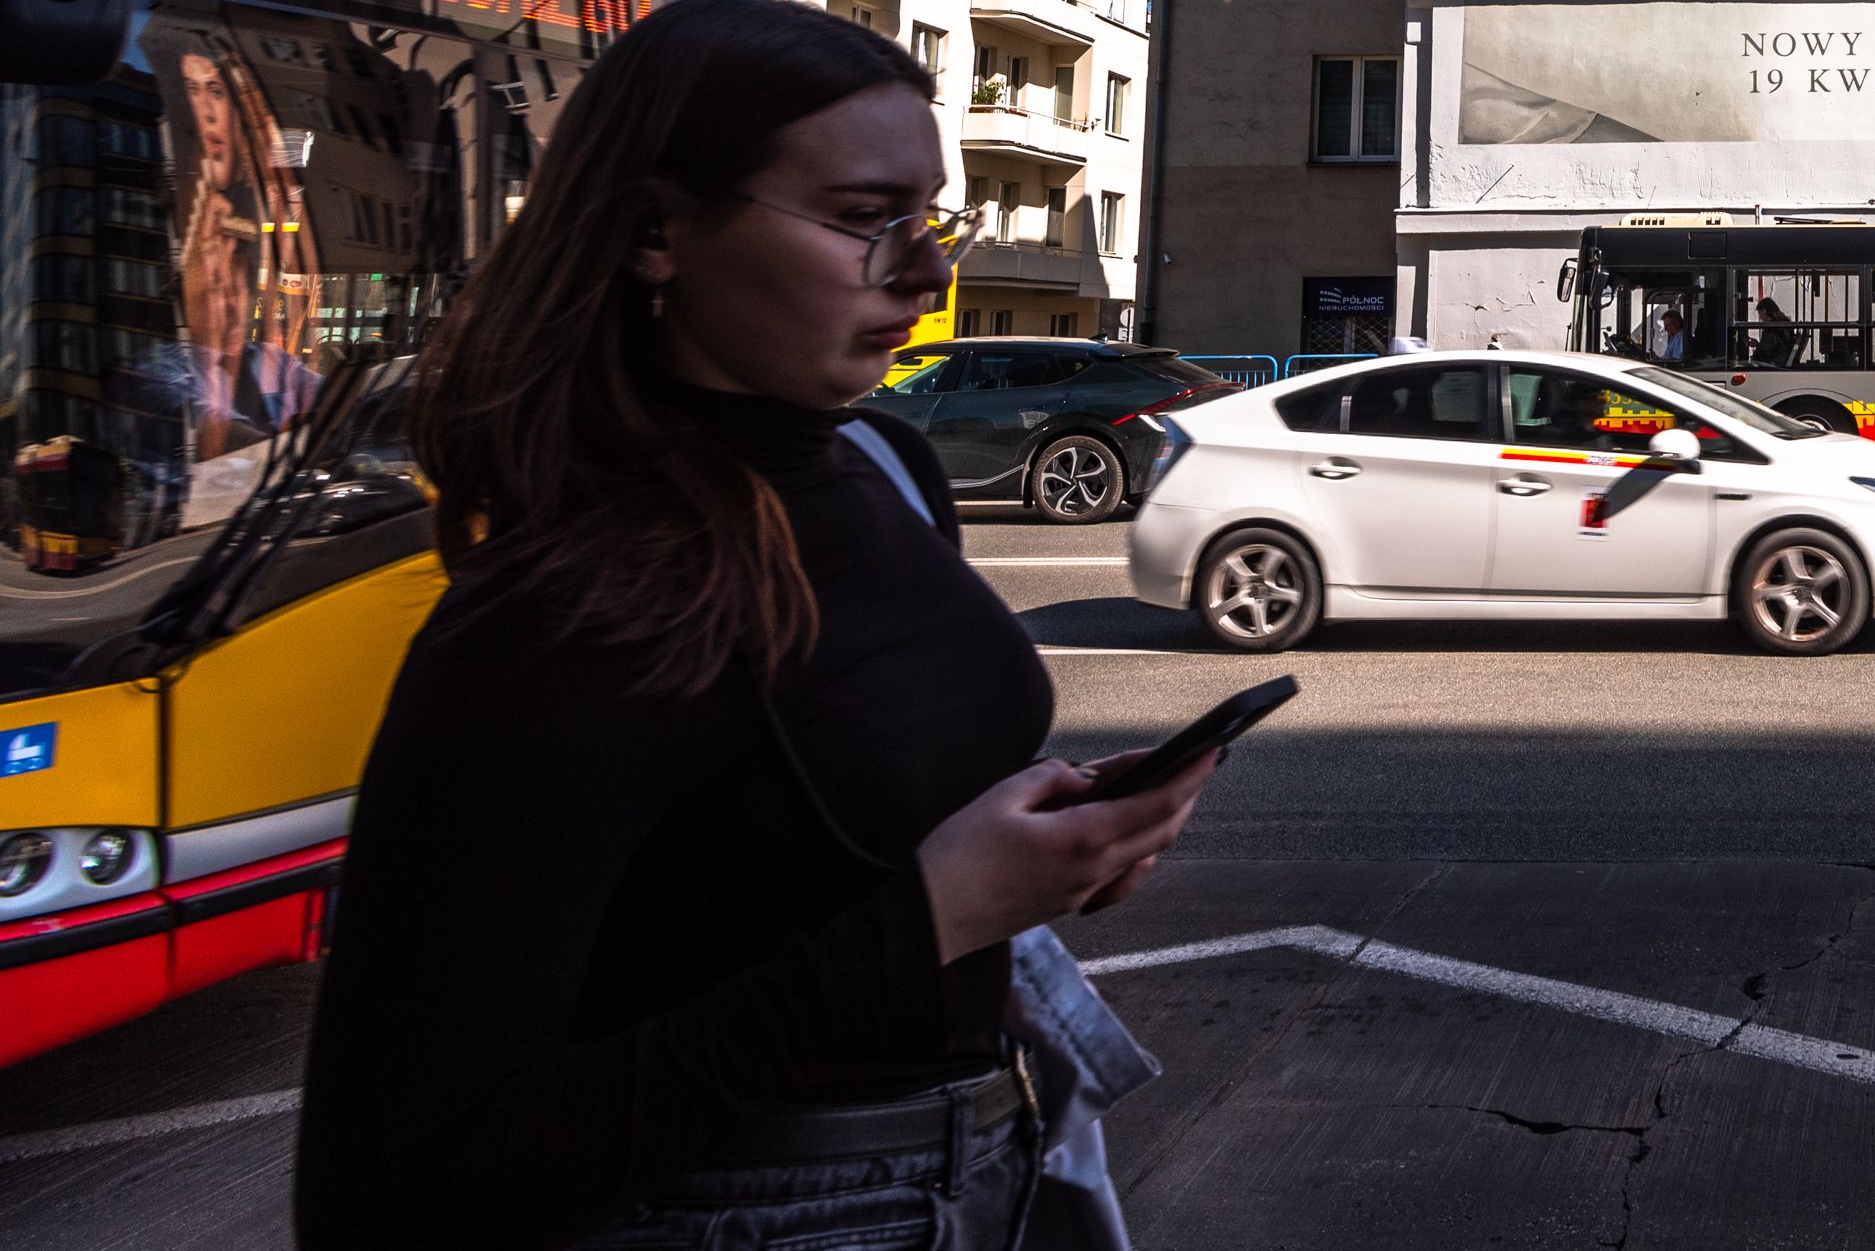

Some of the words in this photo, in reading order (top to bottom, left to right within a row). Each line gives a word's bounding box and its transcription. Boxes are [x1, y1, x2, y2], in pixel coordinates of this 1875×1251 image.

[1740, 31, 1863, 58] NOWY
[1747, 68, 1784, 94] 19
[1342, 295, 1385, 305] PÓŁNOC
